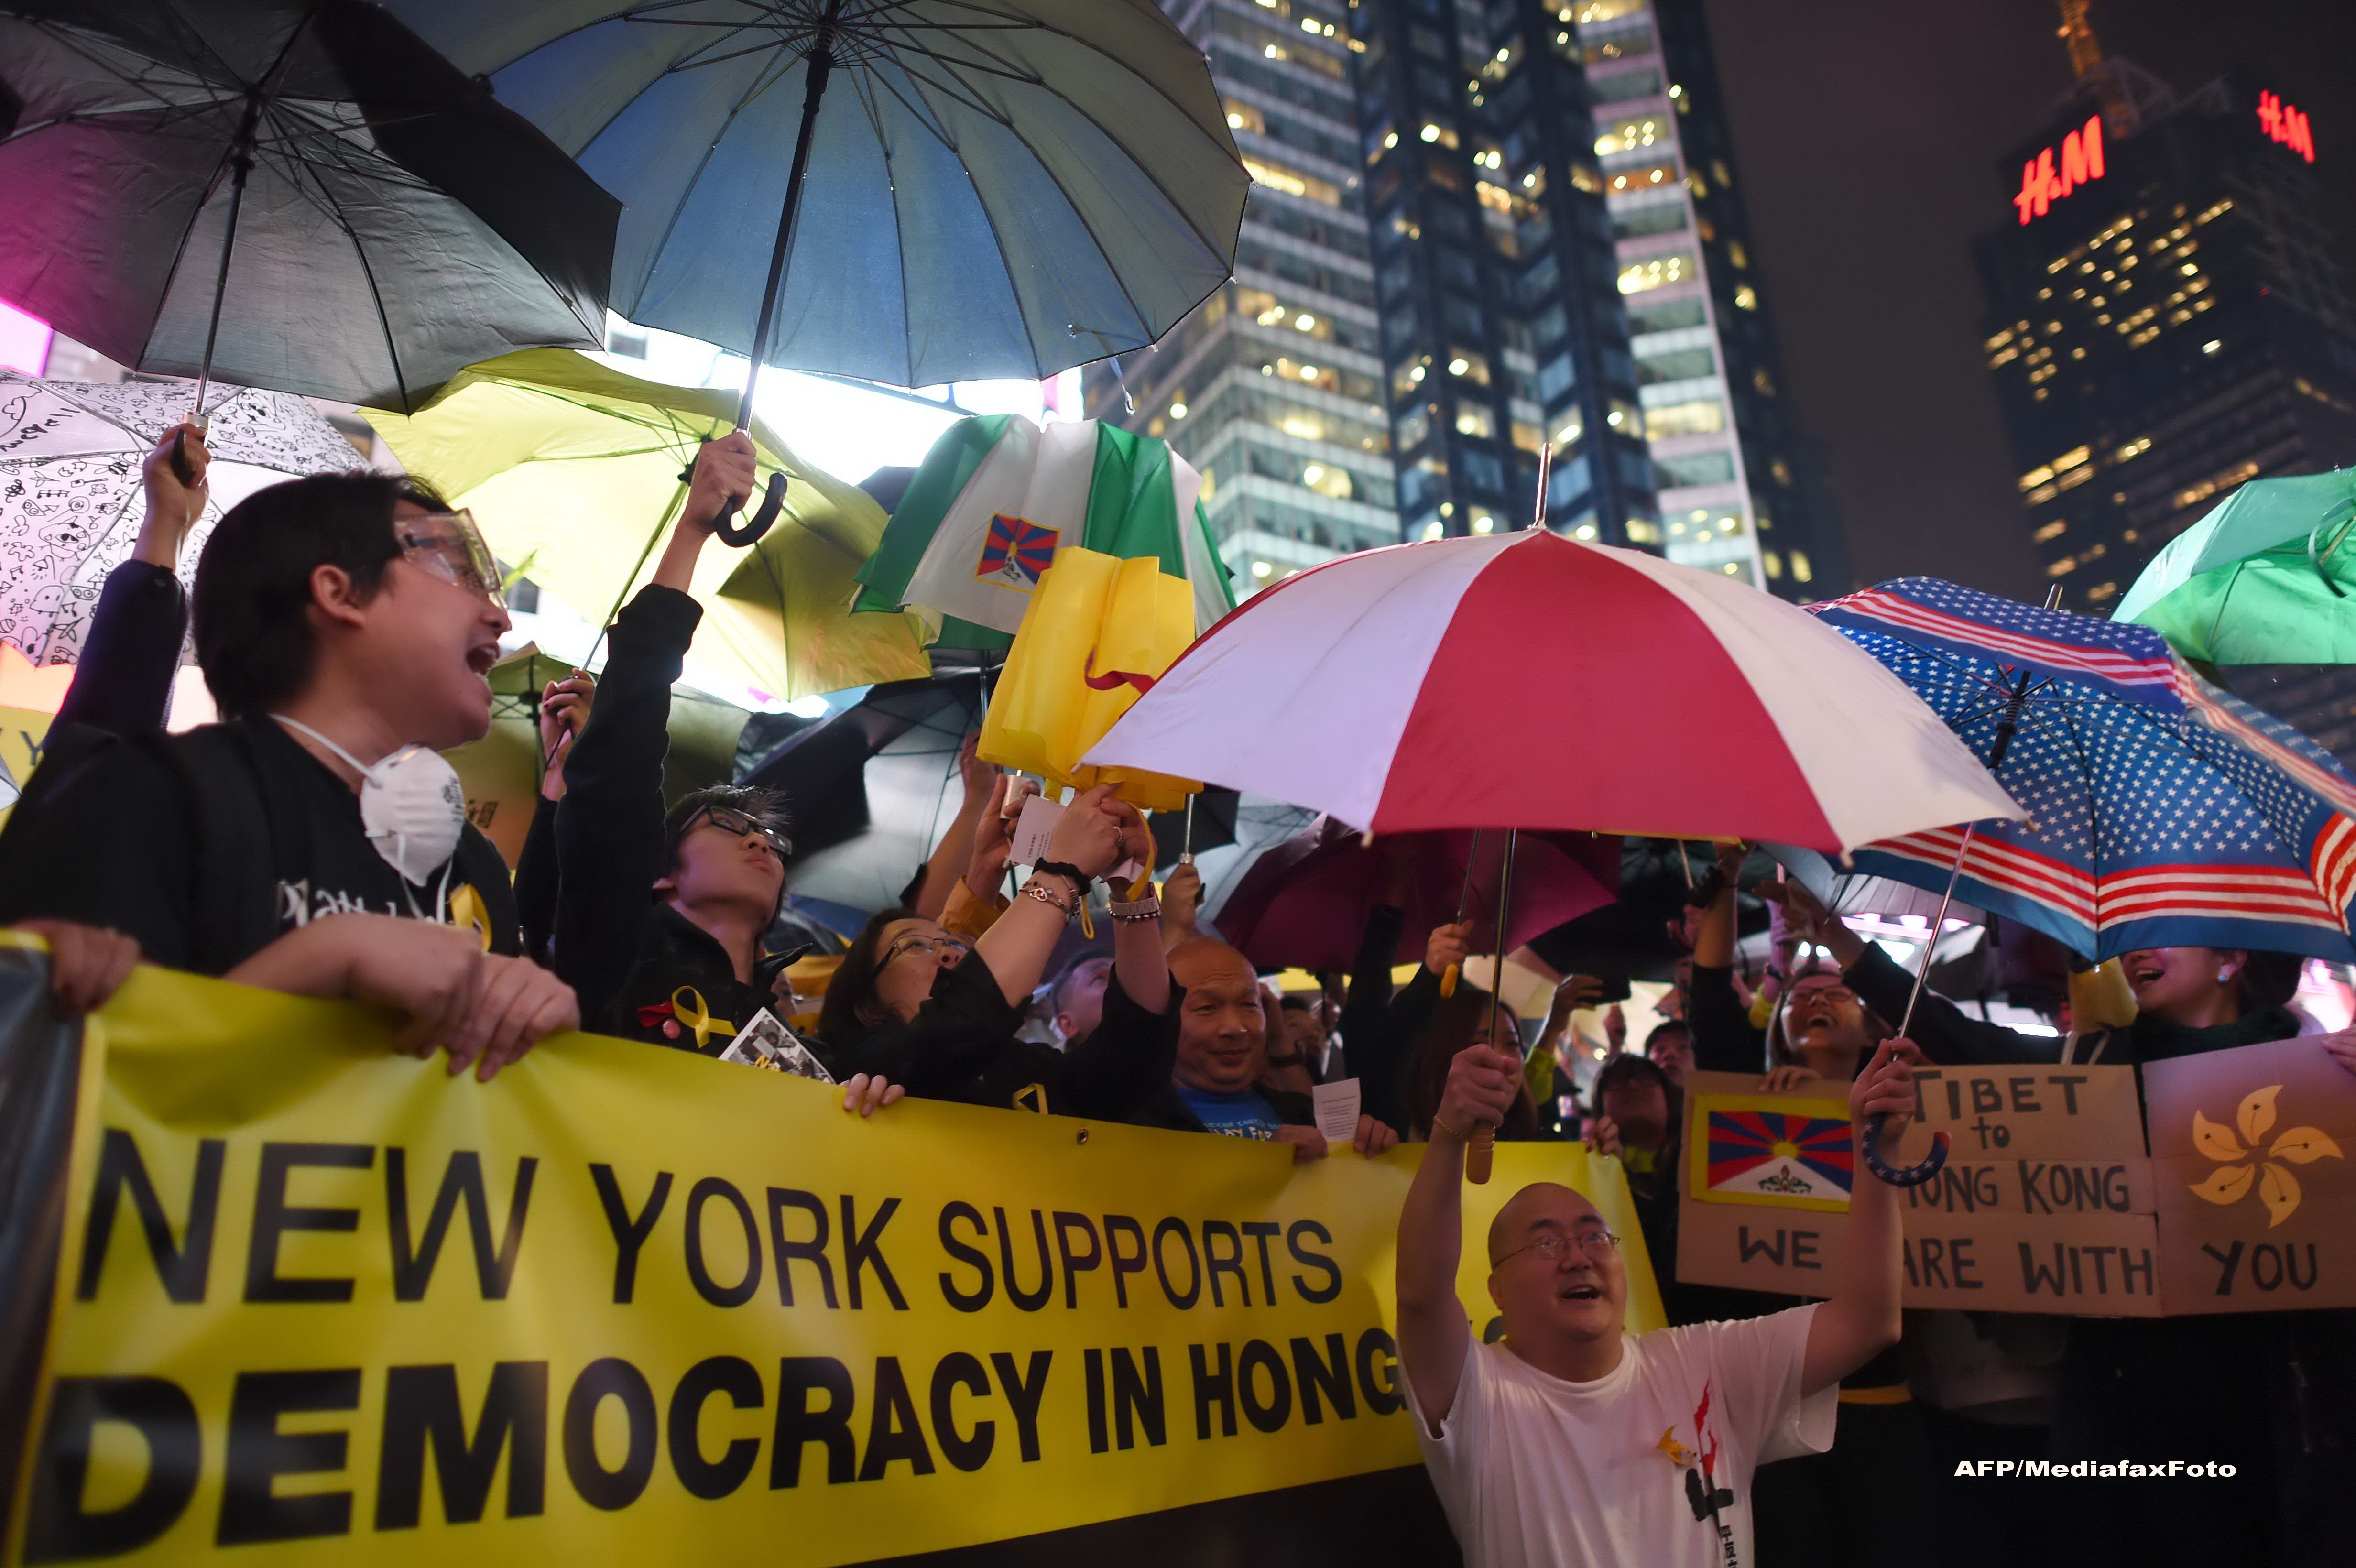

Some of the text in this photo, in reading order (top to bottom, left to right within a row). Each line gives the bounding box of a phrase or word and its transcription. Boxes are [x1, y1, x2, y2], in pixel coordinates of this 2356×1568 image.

[2013, 115, 2105, 226] H&M
[1913, 1070, 2087, 1122] TIBET
[1971, 1117, 2011, 1150] to
[76, 1127, 1342, 1313] NEW YORK SUPPORTS
[2018, 1161, 2130, 1215] KONG
[1738, 1226, 1822, 1269] WE
[2018, 1242, 2152, 1296] WITH
[2202, 1241, 2318, 1296] YOU
[21, 1328, 1408, 1568] DEMOCRACY IN HONG
